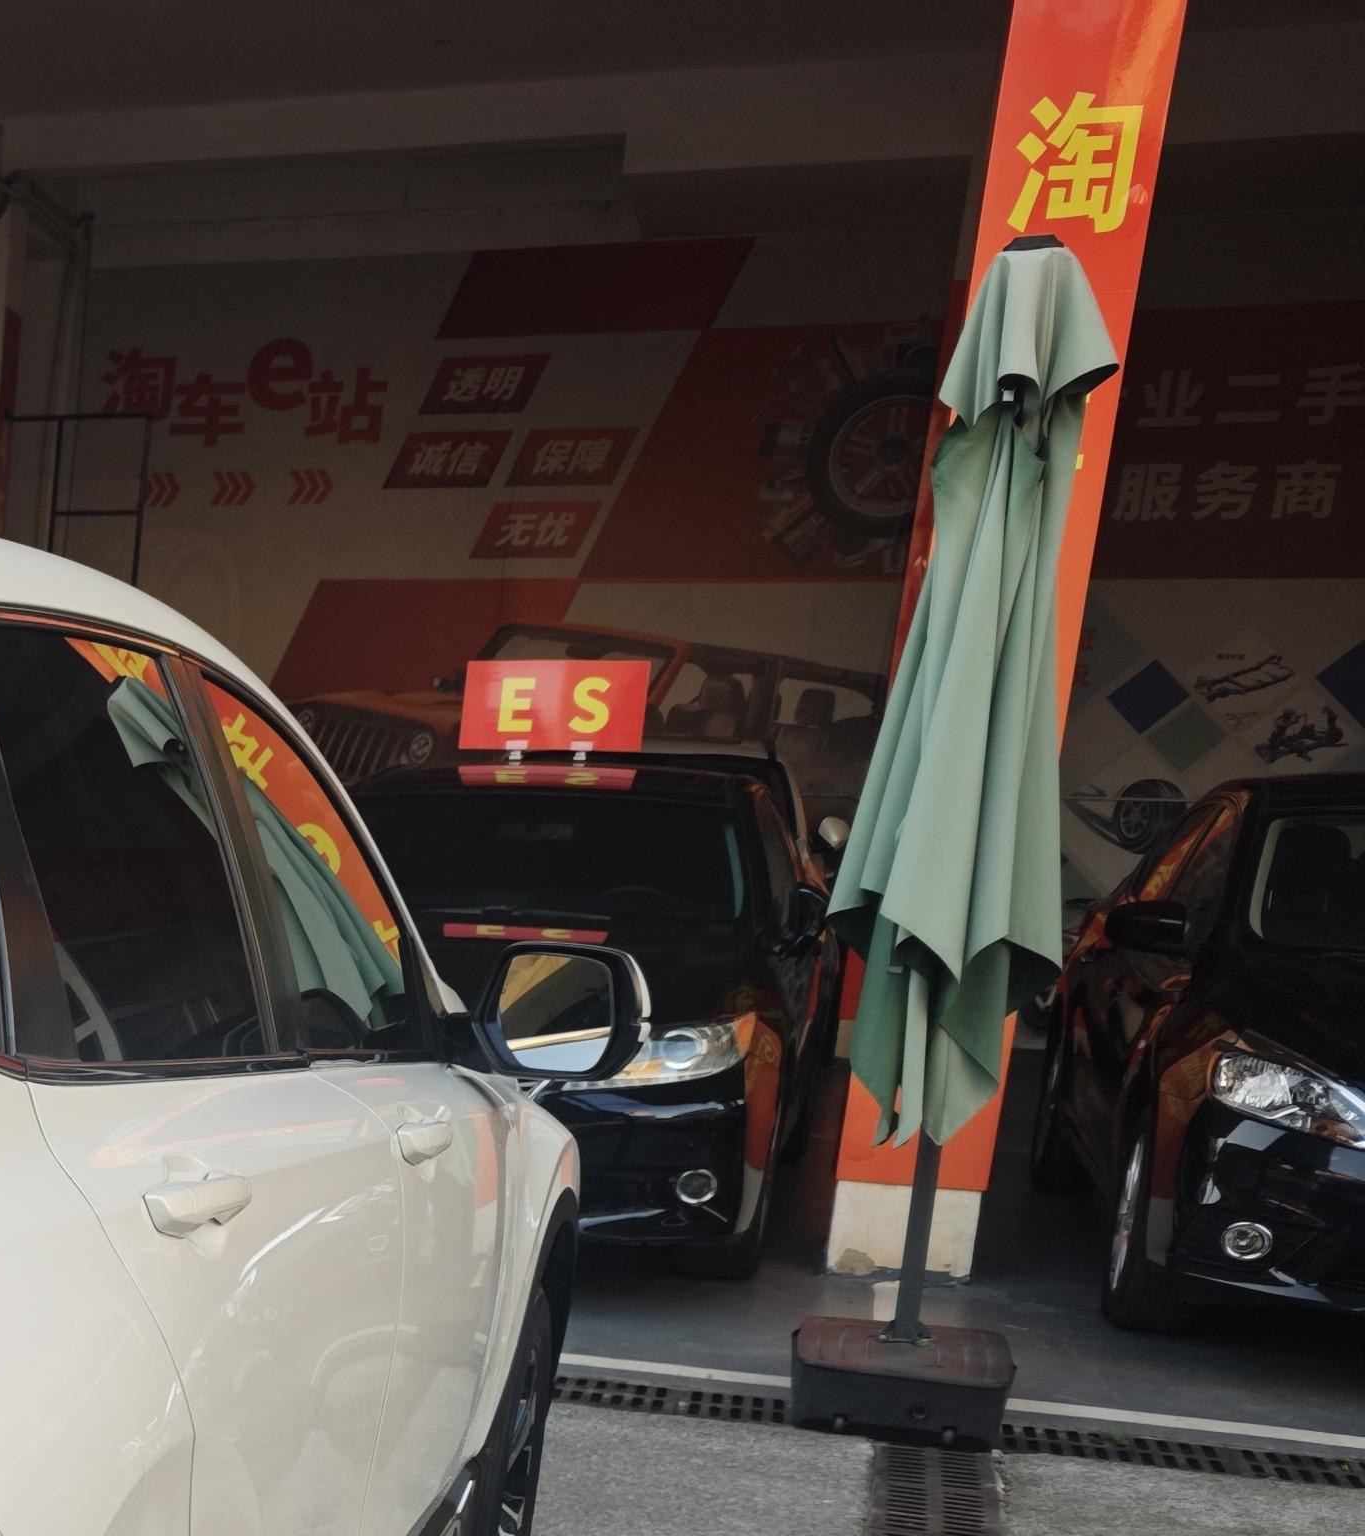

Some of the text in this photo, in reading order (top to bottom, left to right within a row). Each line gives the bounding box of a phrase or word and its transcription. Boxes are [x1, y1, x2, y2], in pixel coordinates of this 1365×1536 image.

[1007, 91, 1144, 233] 淘
[100, 337, 388, 447] 淘车e站
[444, 365, 525, 403] 透明
[1124, 362, 1365, 428] 业二手
[408, 441, 488, 476] 诚信
[532, 437, 614, 475] 保障
[1112, 459, 1342, 521] 服务商
[495, 512, 575, 548] 无忧
